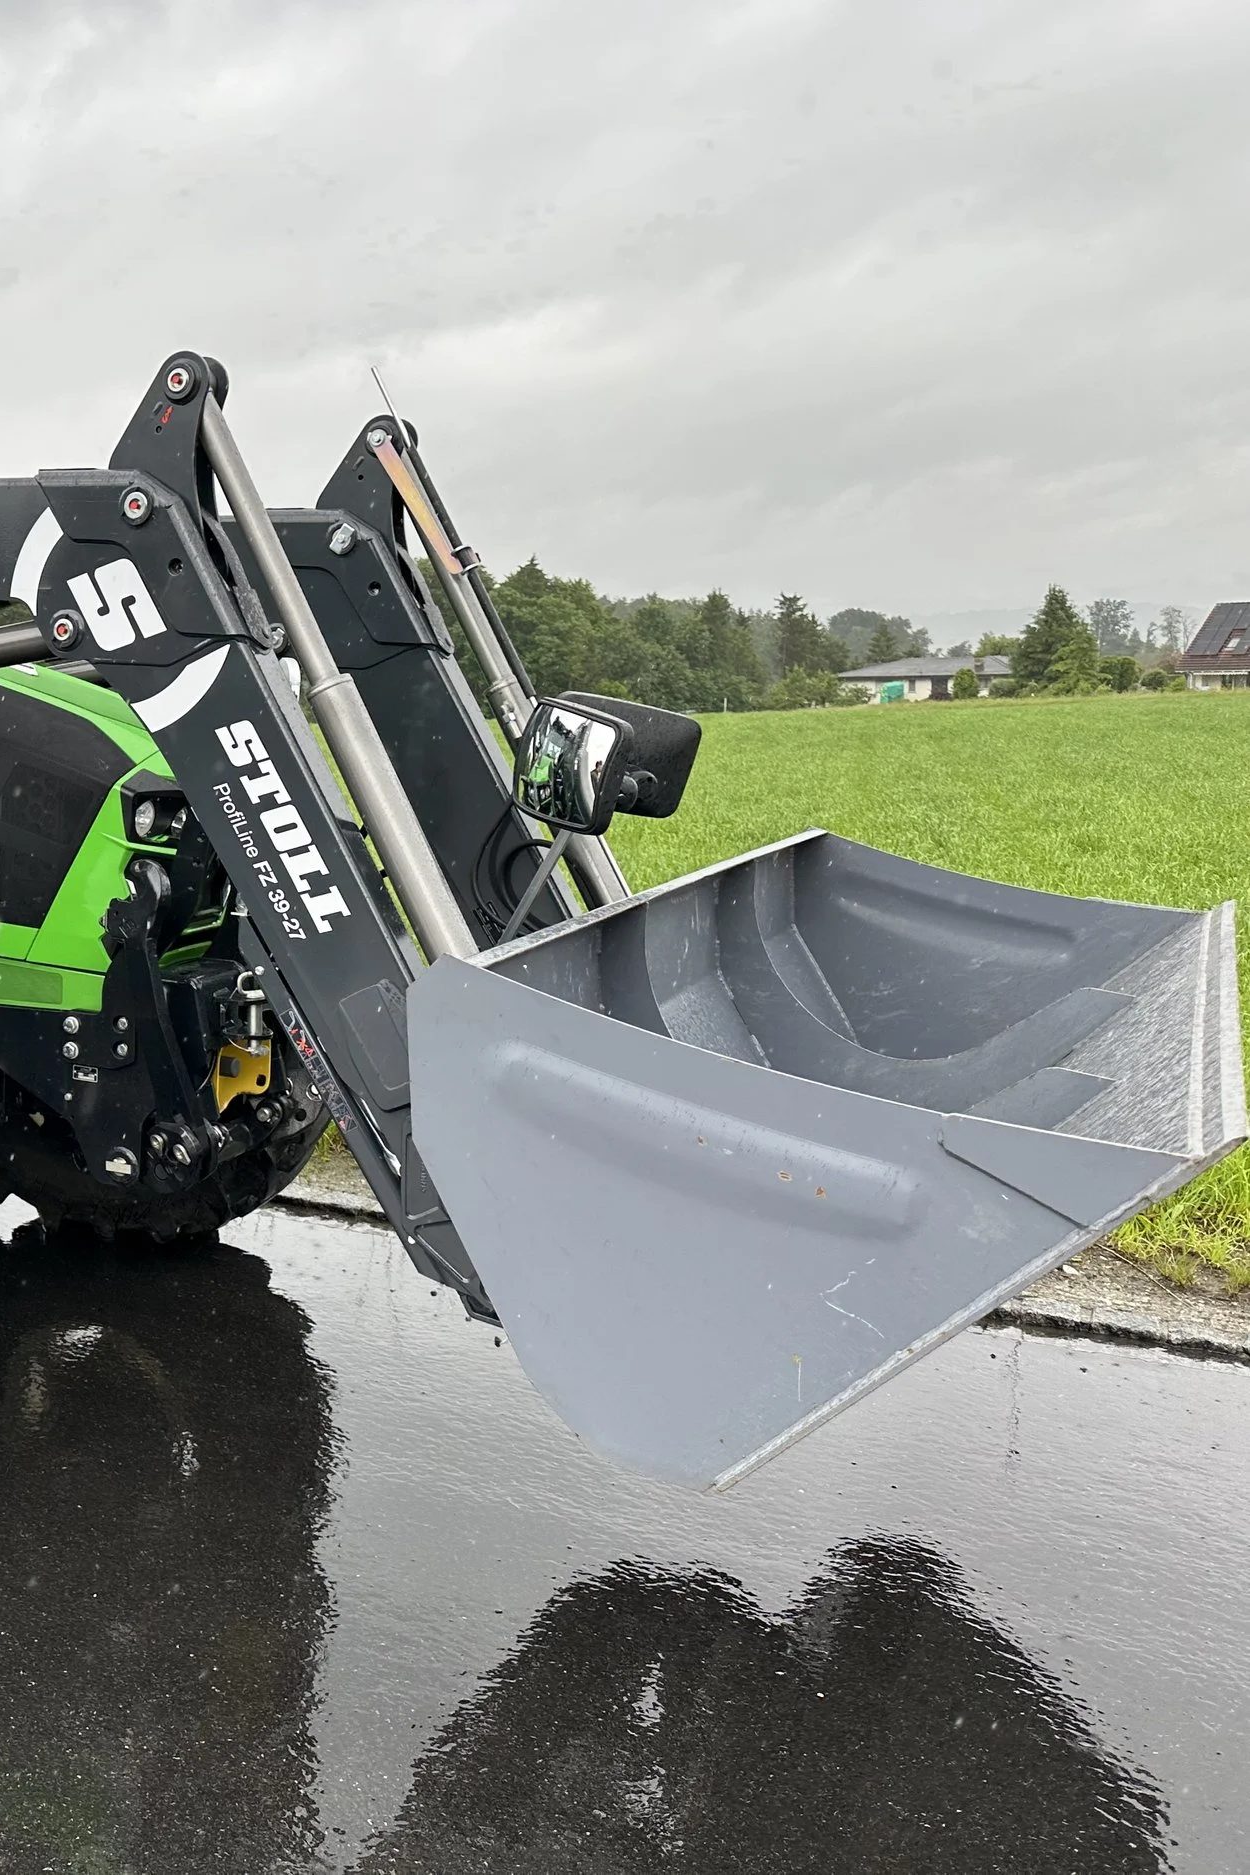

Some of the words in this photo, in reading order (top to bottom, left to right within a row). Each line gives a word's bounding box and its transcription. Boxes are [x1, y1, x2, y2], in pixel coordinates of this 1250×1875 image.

[66, 558, 168, 652] S
[212, 782, 259, 858] ProfiLine
[252, 860, 278, 888] FZ
[268, 888, 307, 940] 39-27
[214, 719, 352, 934] STOLL
